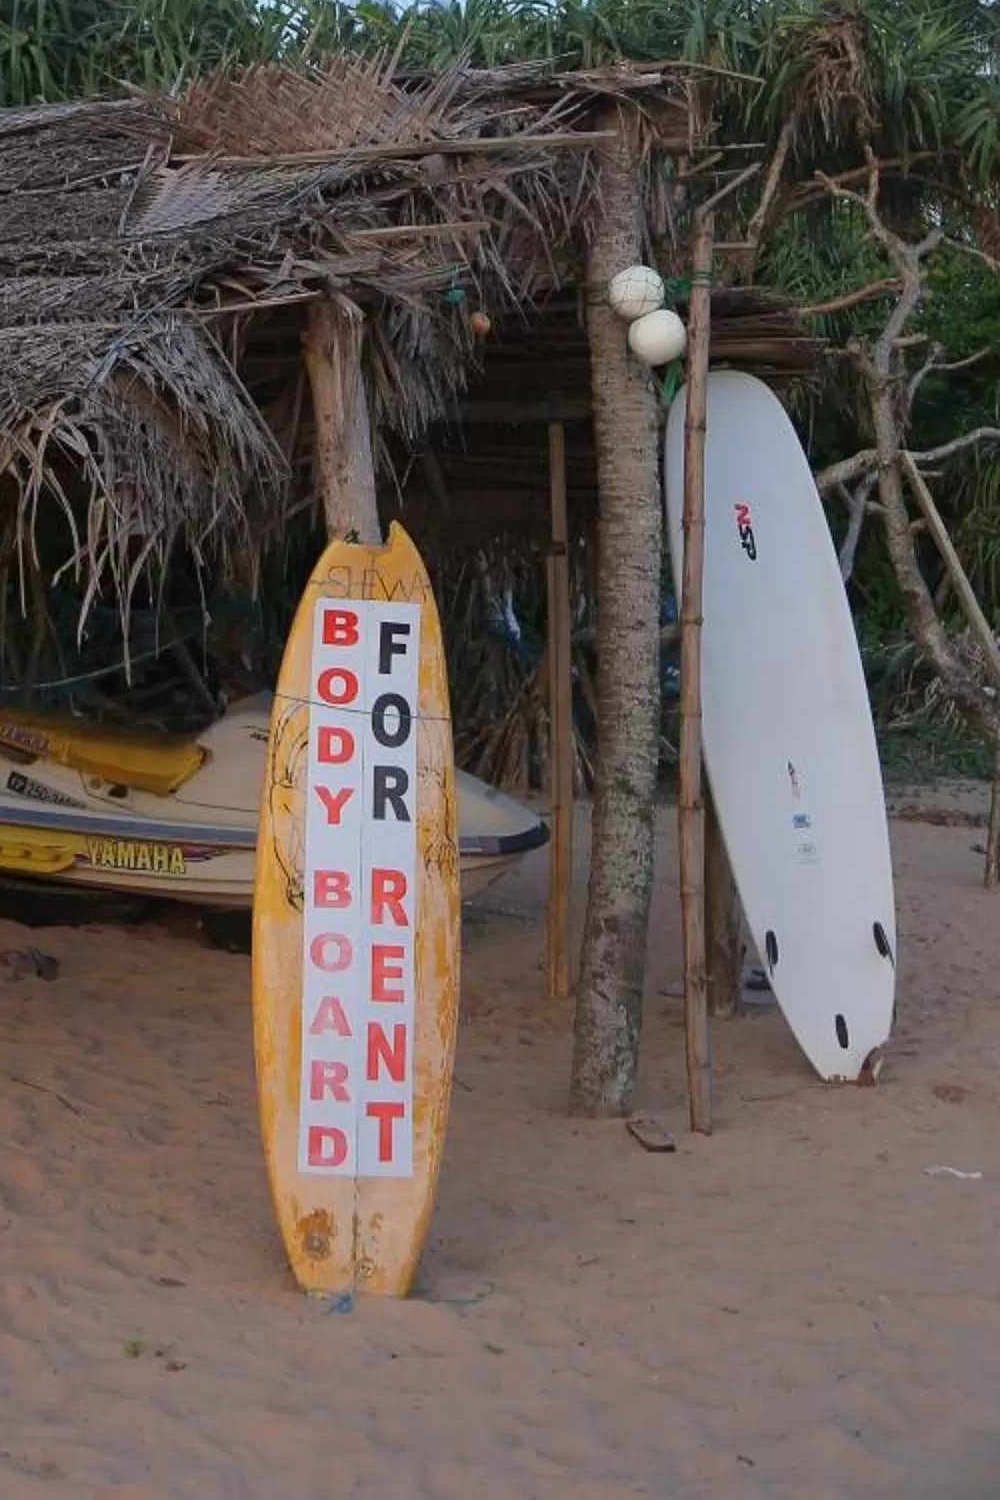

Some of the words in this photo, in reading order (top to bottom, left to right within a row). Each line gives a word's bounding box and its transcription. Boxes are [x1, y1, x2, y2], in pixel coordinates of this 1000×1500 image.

[313, 609, 360, 826] BODY
[370, 621, 411, 823] FOR
[85, 835, 187, 876] YAMAHA
[307, 869, 353, 1168] BOARD
[365, 867, 409, 1164] RENT
